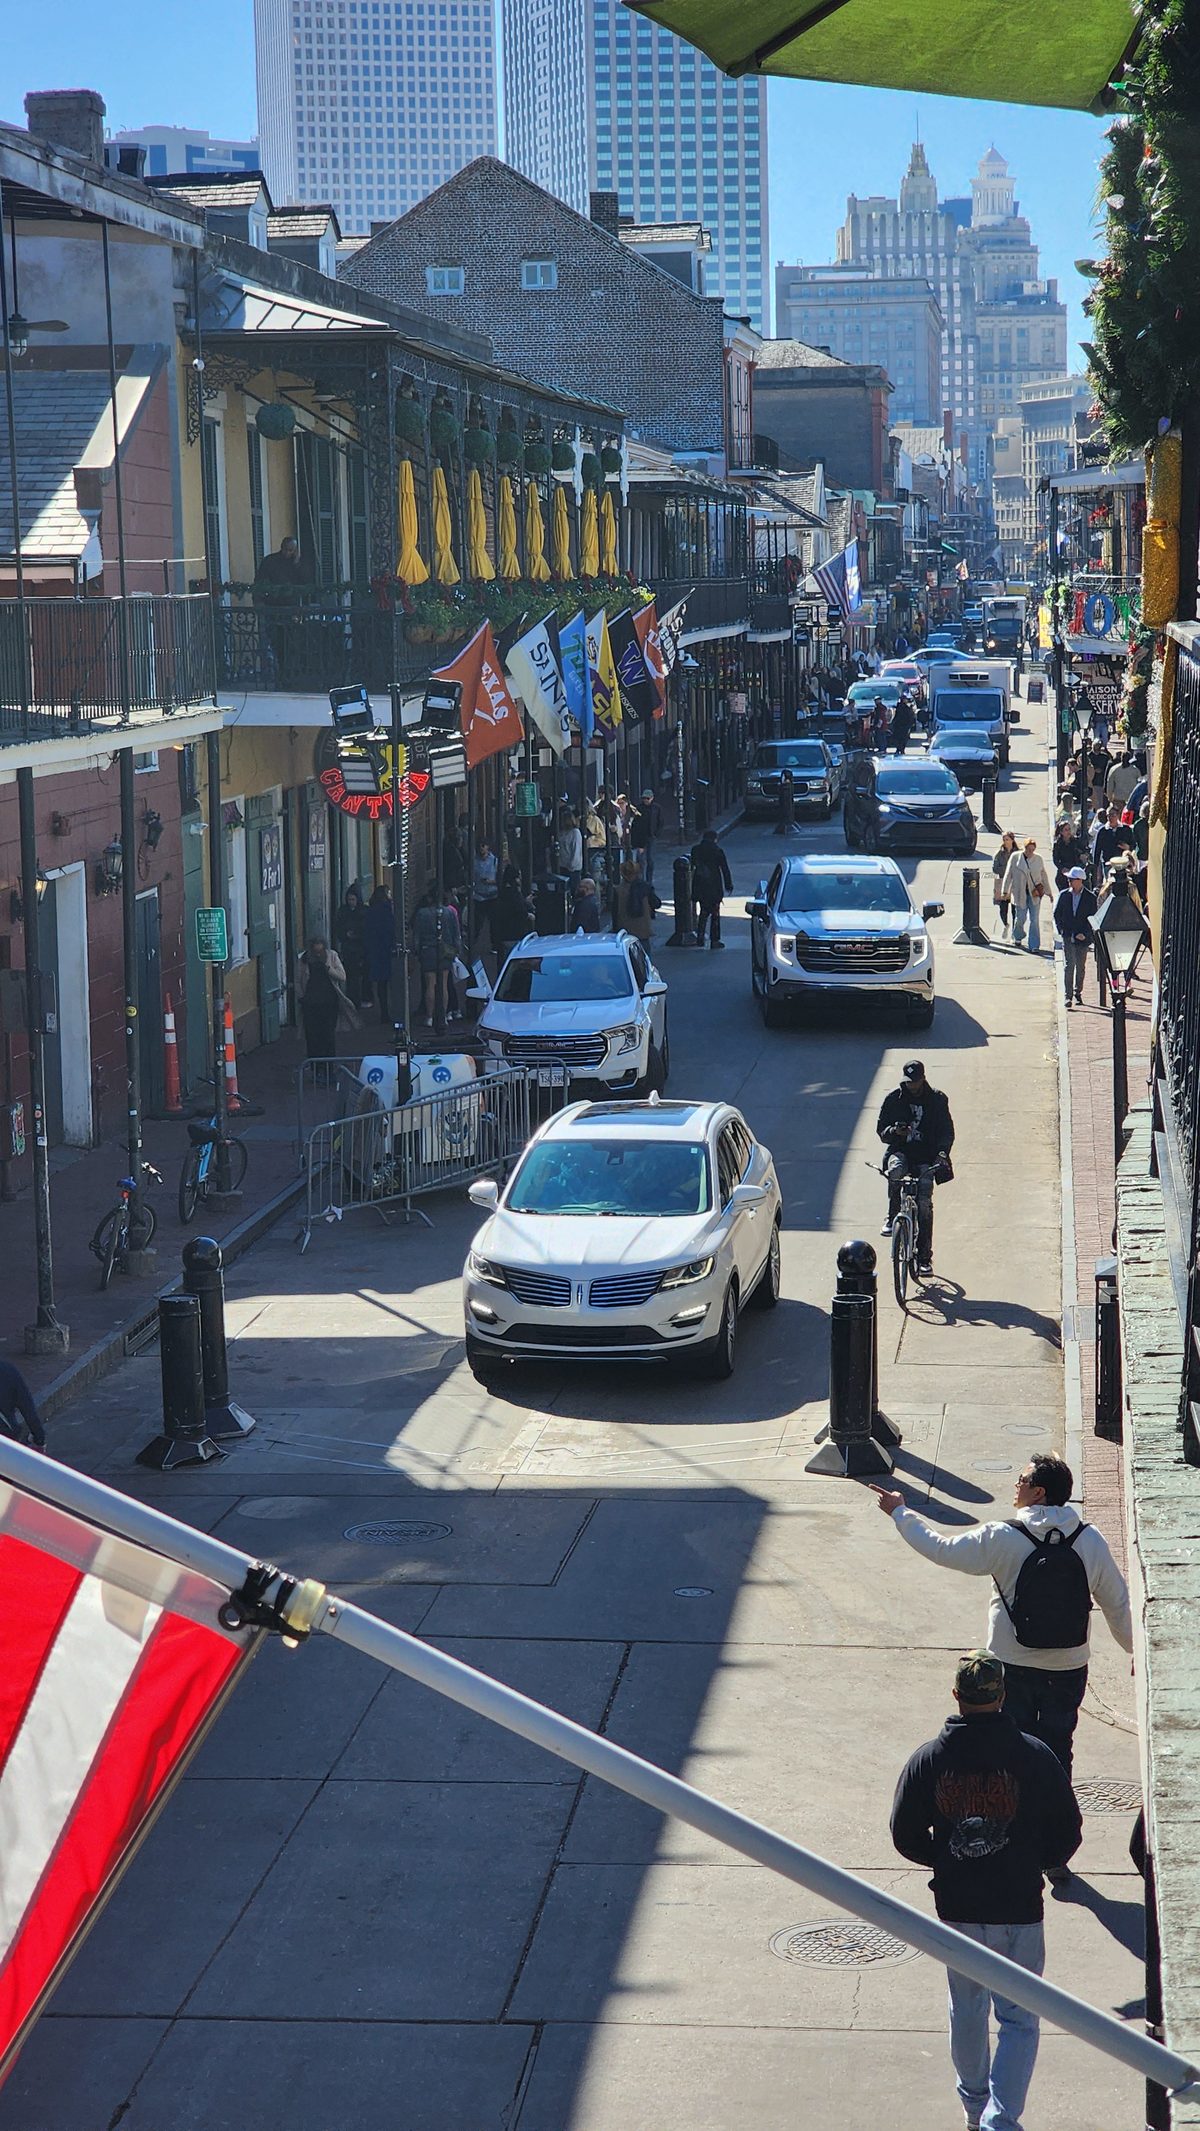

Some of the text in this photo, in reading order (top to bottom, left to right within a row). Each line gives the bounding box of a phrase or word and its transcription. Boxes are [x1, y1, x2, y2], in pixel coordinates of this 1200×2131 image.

[1068, 591, 1142, 640] JOY
[481, 661, 509, 719] EXAS
[529, 641, 570, 732] SAINTS
[262, 868, 268, 890] 2
[833, 944, 875, 953] GMC
[810, 1929, 886, 1963] SEWER
